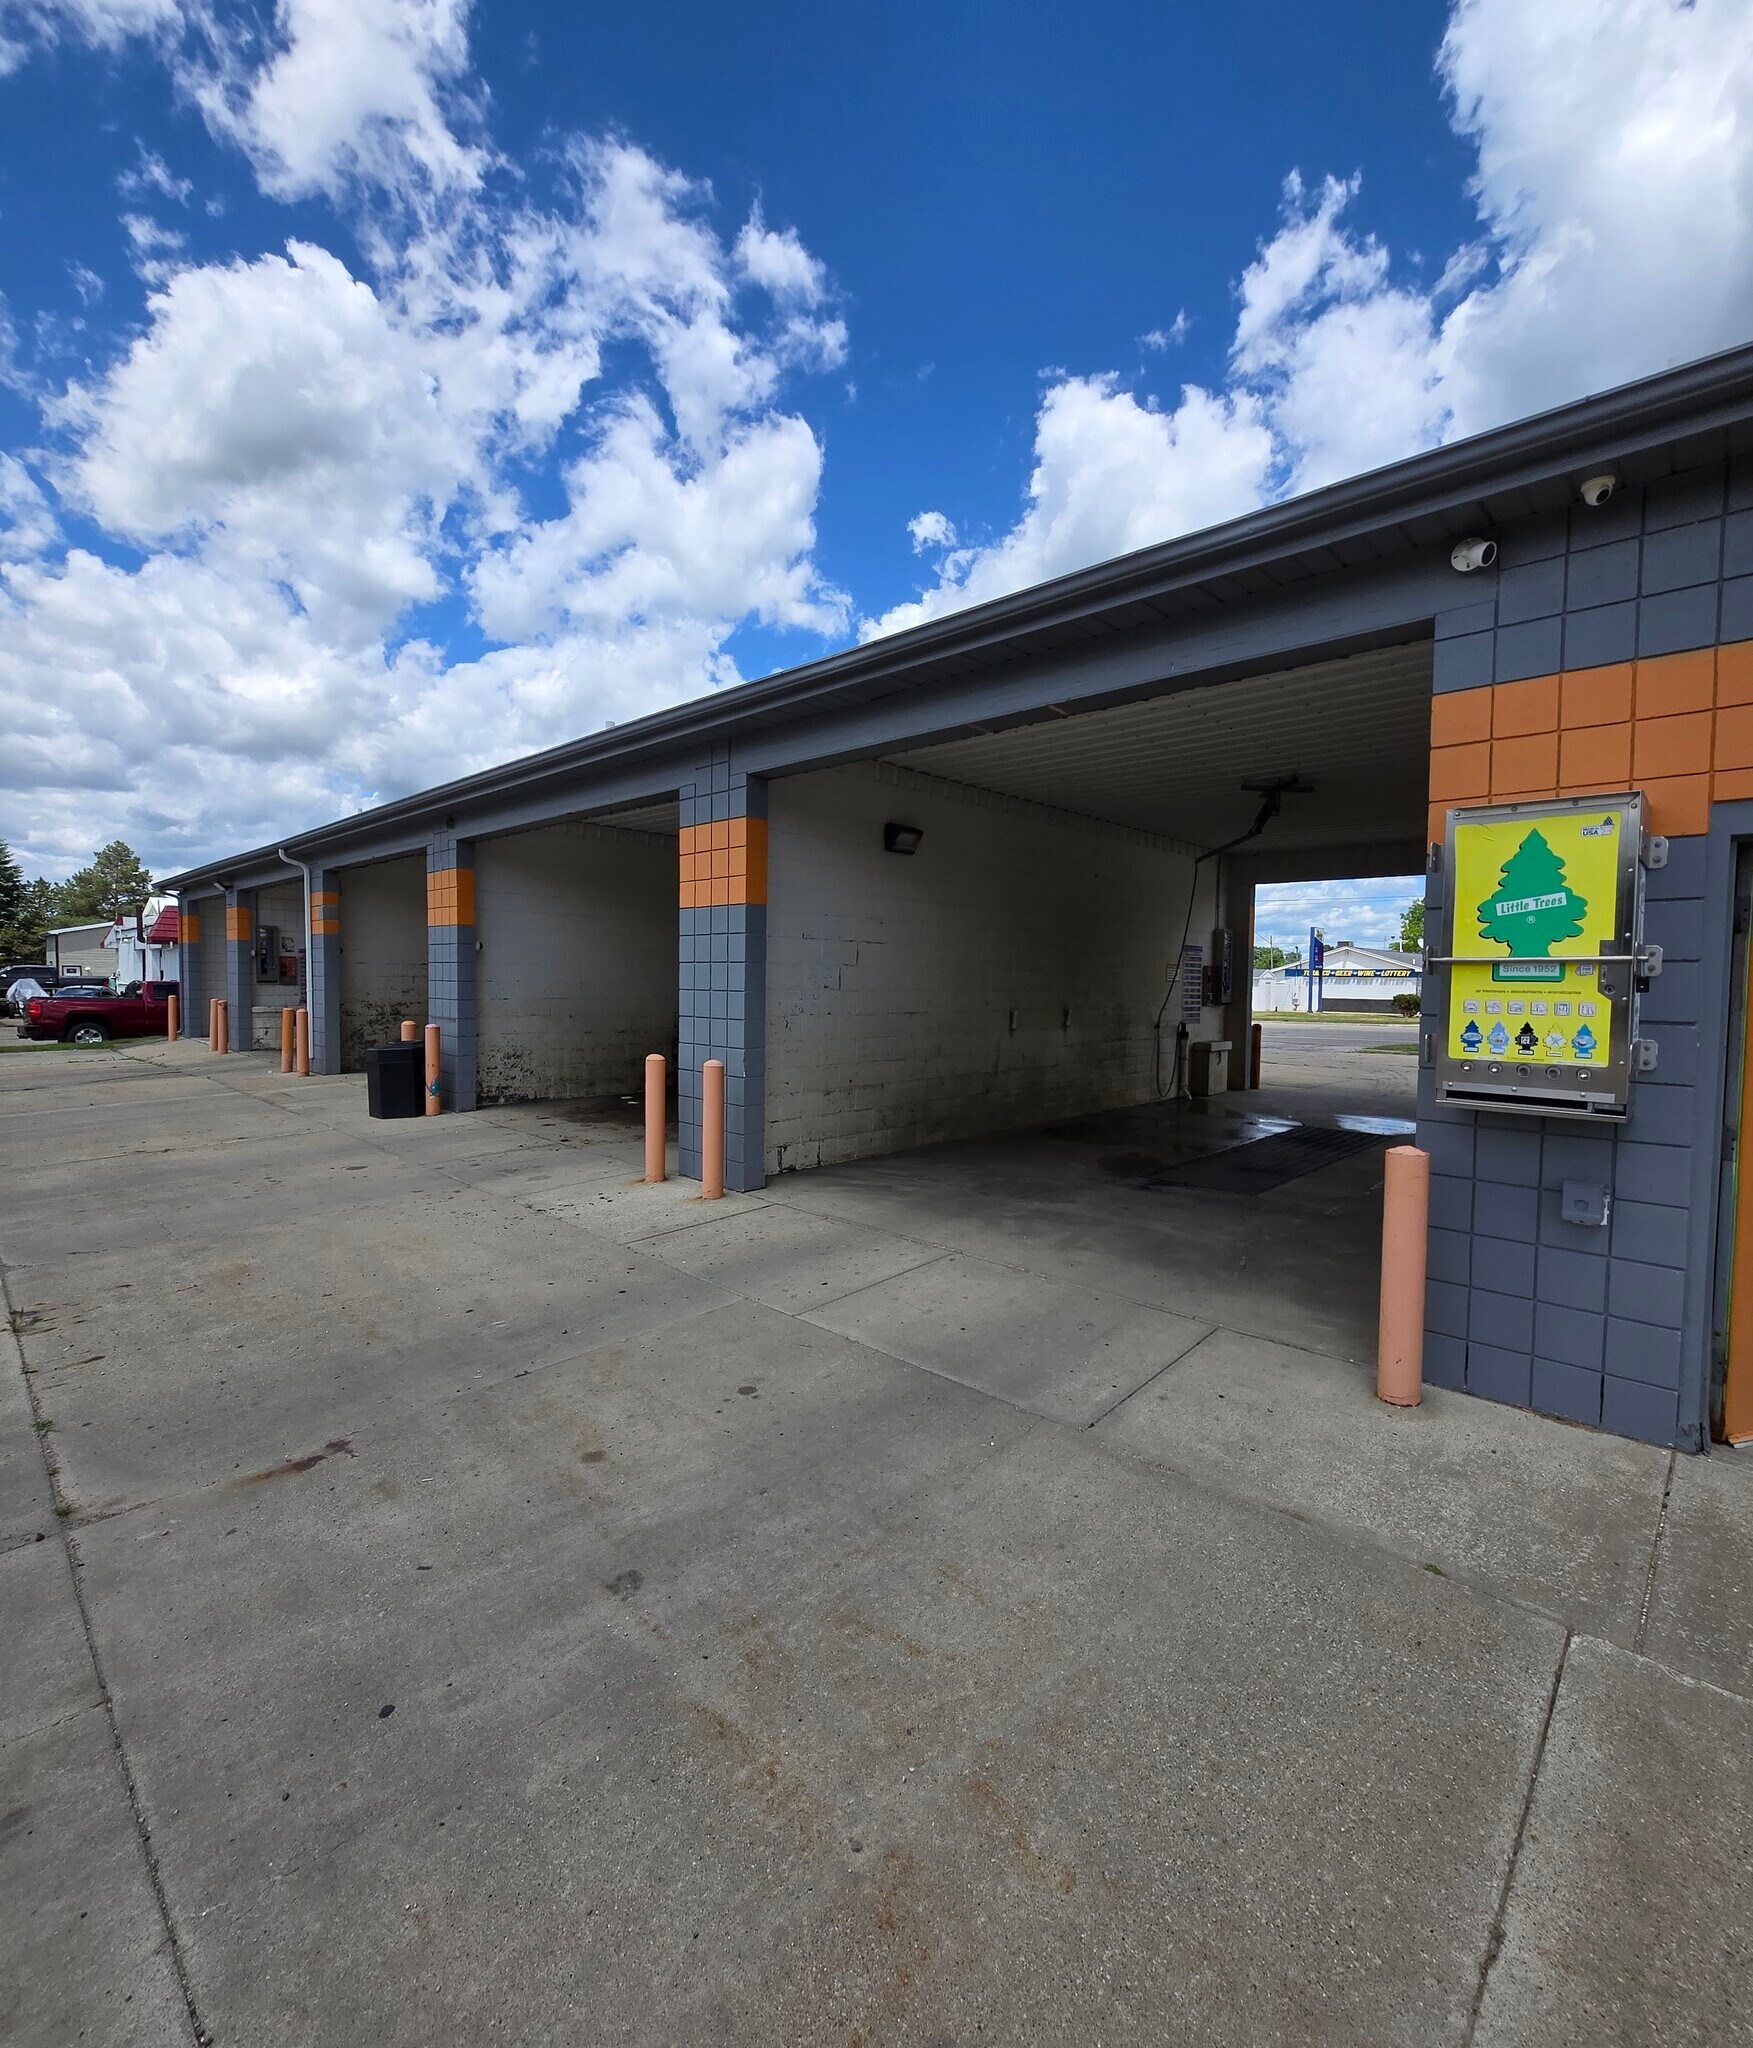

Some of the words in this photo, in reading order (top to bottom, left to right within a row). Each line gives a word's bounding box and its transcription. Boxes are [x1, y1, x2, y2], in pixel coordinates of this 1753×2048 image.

[1500, 900, 1530, 914] Little
[1532, 896, 1564, 909] Trees
[1502, 964, 1531, 973] Since
[1533, 964, 1557, 973] 1952
